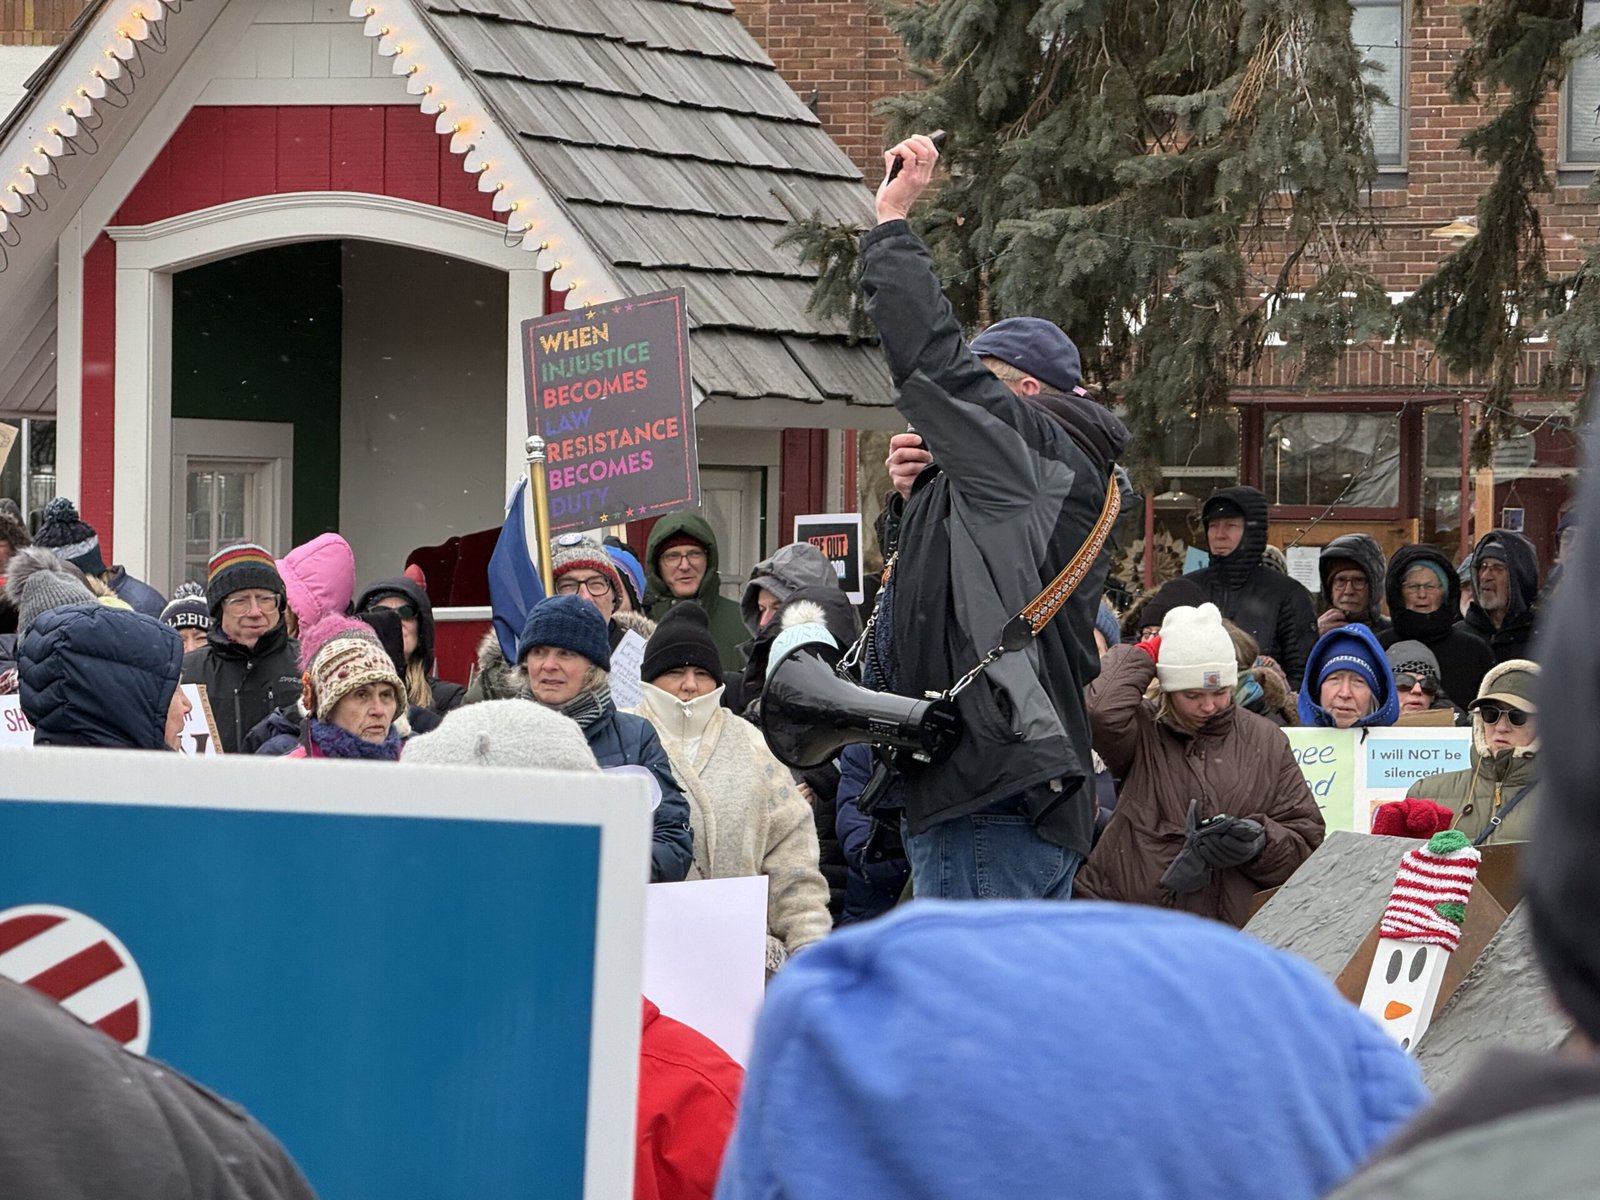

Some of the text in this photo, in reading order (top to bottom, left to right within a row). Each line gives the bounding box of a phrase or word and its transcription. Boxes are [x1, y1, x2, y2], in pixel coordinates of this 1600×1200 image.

[540, 323, 609, 354] WHEN
[542, 341, 650, 382] INJUSTICE
[543, 369, 648, 410] BECOMES
[545, 408, 592, 436] LAW
[547, 417, 679, 464] RESISTANCE
[549, 450, 654, 490] BECOMES
[551, 486, 610, 518] DUTY
[827, 536, 846, 558] OUT
[4, 708, 35, 731] SH
[1380, 749, 1403, 760] will
[1408, 749, 1440, 760] NOT
[1445, 749, 1462, 760] be
